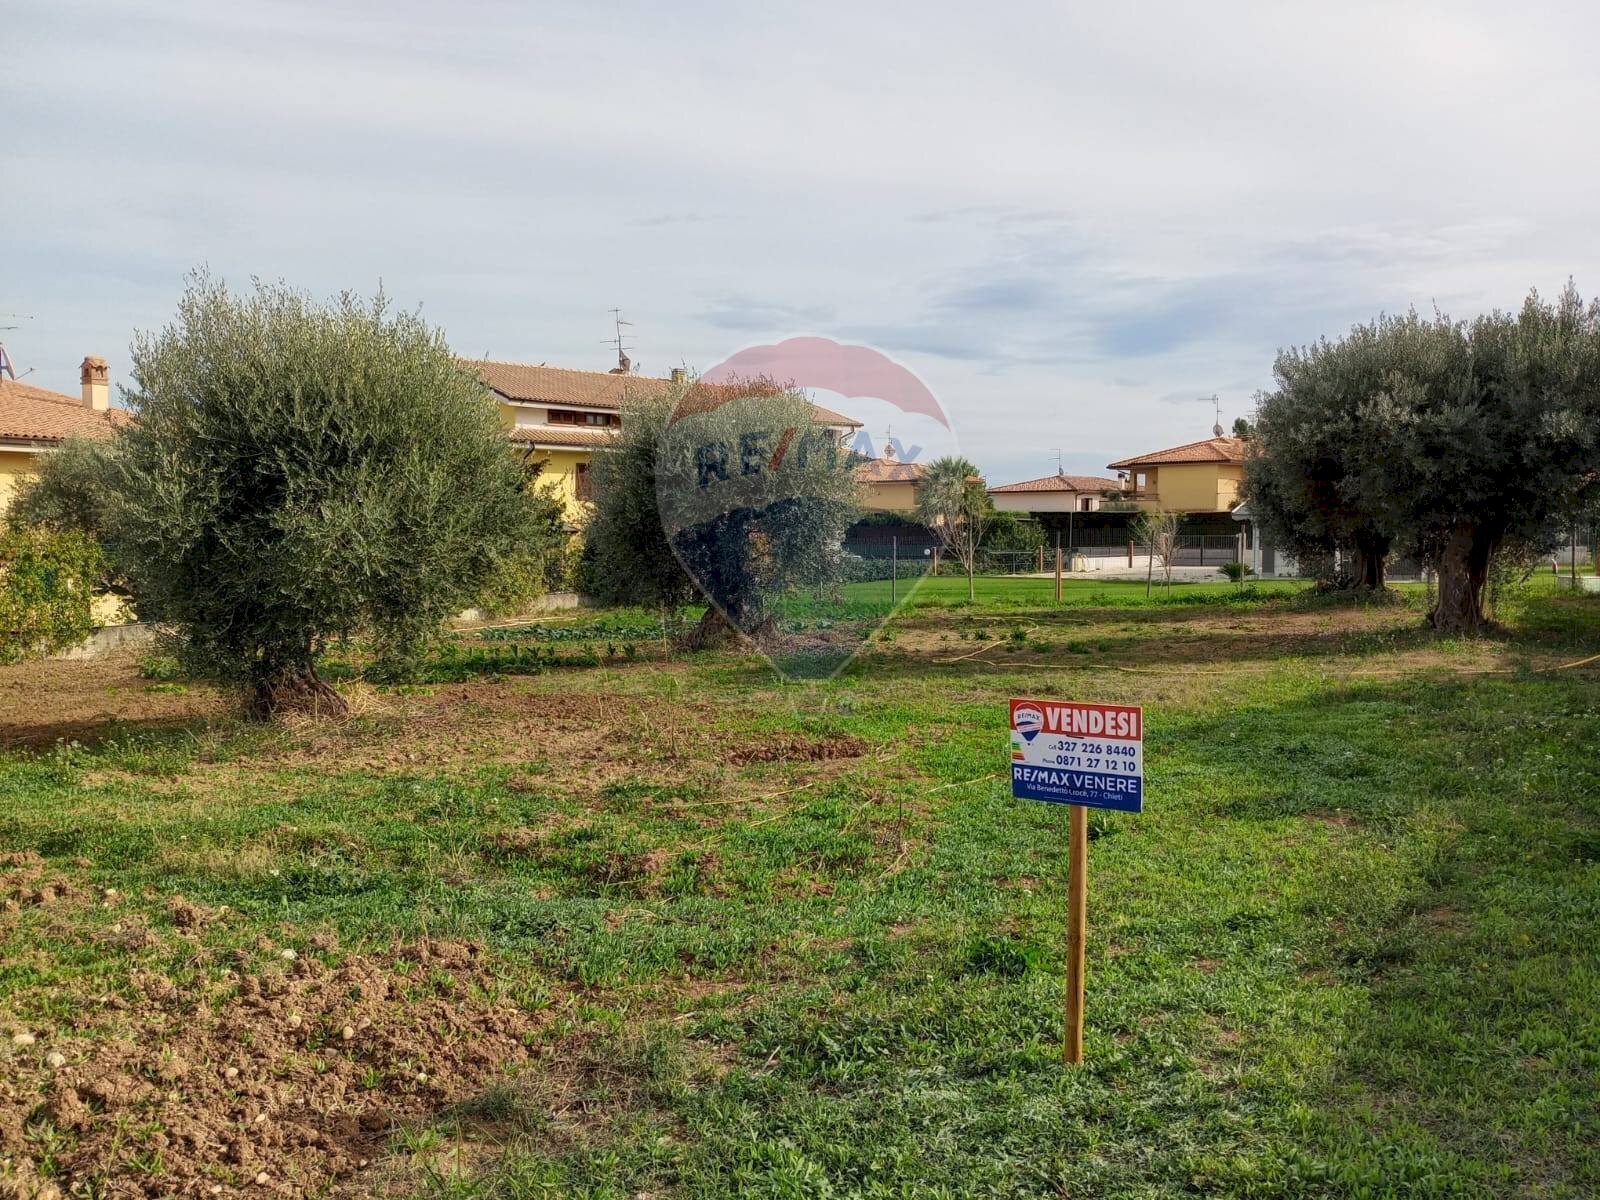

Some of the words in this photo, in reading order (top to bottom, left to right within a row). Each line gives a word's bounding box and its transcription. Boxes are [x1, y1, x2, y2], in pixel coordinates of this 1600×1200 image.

[1045, 706, 1137, 737] VENDESI
[1057, 740, 1077, 751] 327
[1081, 743, 1102, 754] 226
[1106, 745, 1136, 757] 8440
[1056, 755, 1081, 767] 0871
[1086, 758, 1100, 769] 27
[1105, 759, 1118, 770] 12
[1123, 761, 1136, 772] 10
[1013, 767, 1071, 787] RE/MAX
[1072, 774, 1138, 794] VENERE
